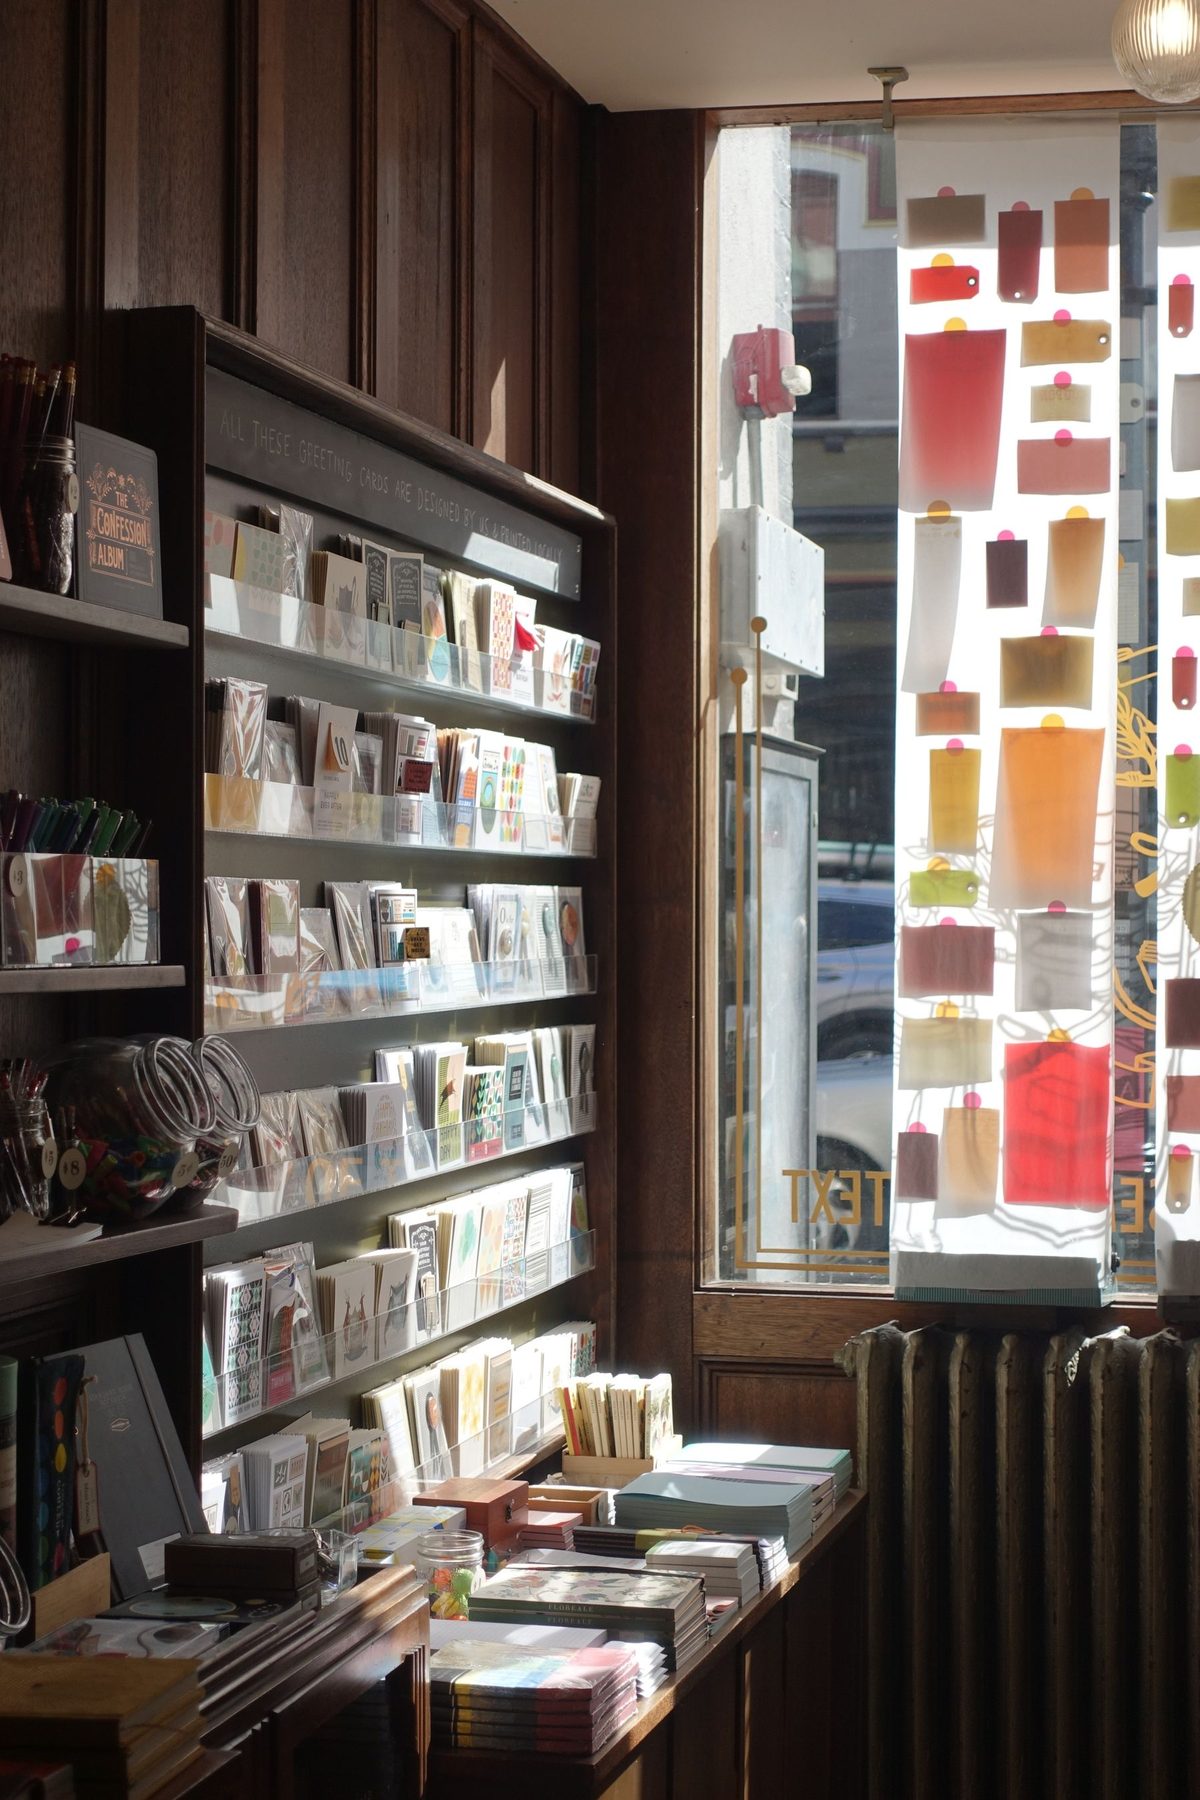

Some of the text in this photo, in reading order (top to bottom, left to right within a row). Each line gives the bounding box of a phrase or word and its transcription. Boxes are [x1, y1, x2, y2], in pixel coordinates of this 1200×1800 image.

[219, 410, 244, 441] ALL
[253, 420, 290, 457] THESE
[299, 439, 352, 482] GREETING
[360, 466, 389, 494] CARDS
[395, 480, 411, 503] ARE
[417, 488, 459, 522] DESIGNED
[464, 509, 476, 528] BY
[480, 518, 489, 537] US
[500, 525, 530, 553] PRINTED
[115, 491, 128, 509] THE
[97, 543, 124, 571] ALBUM
[333, 736, 349, 766] 10
